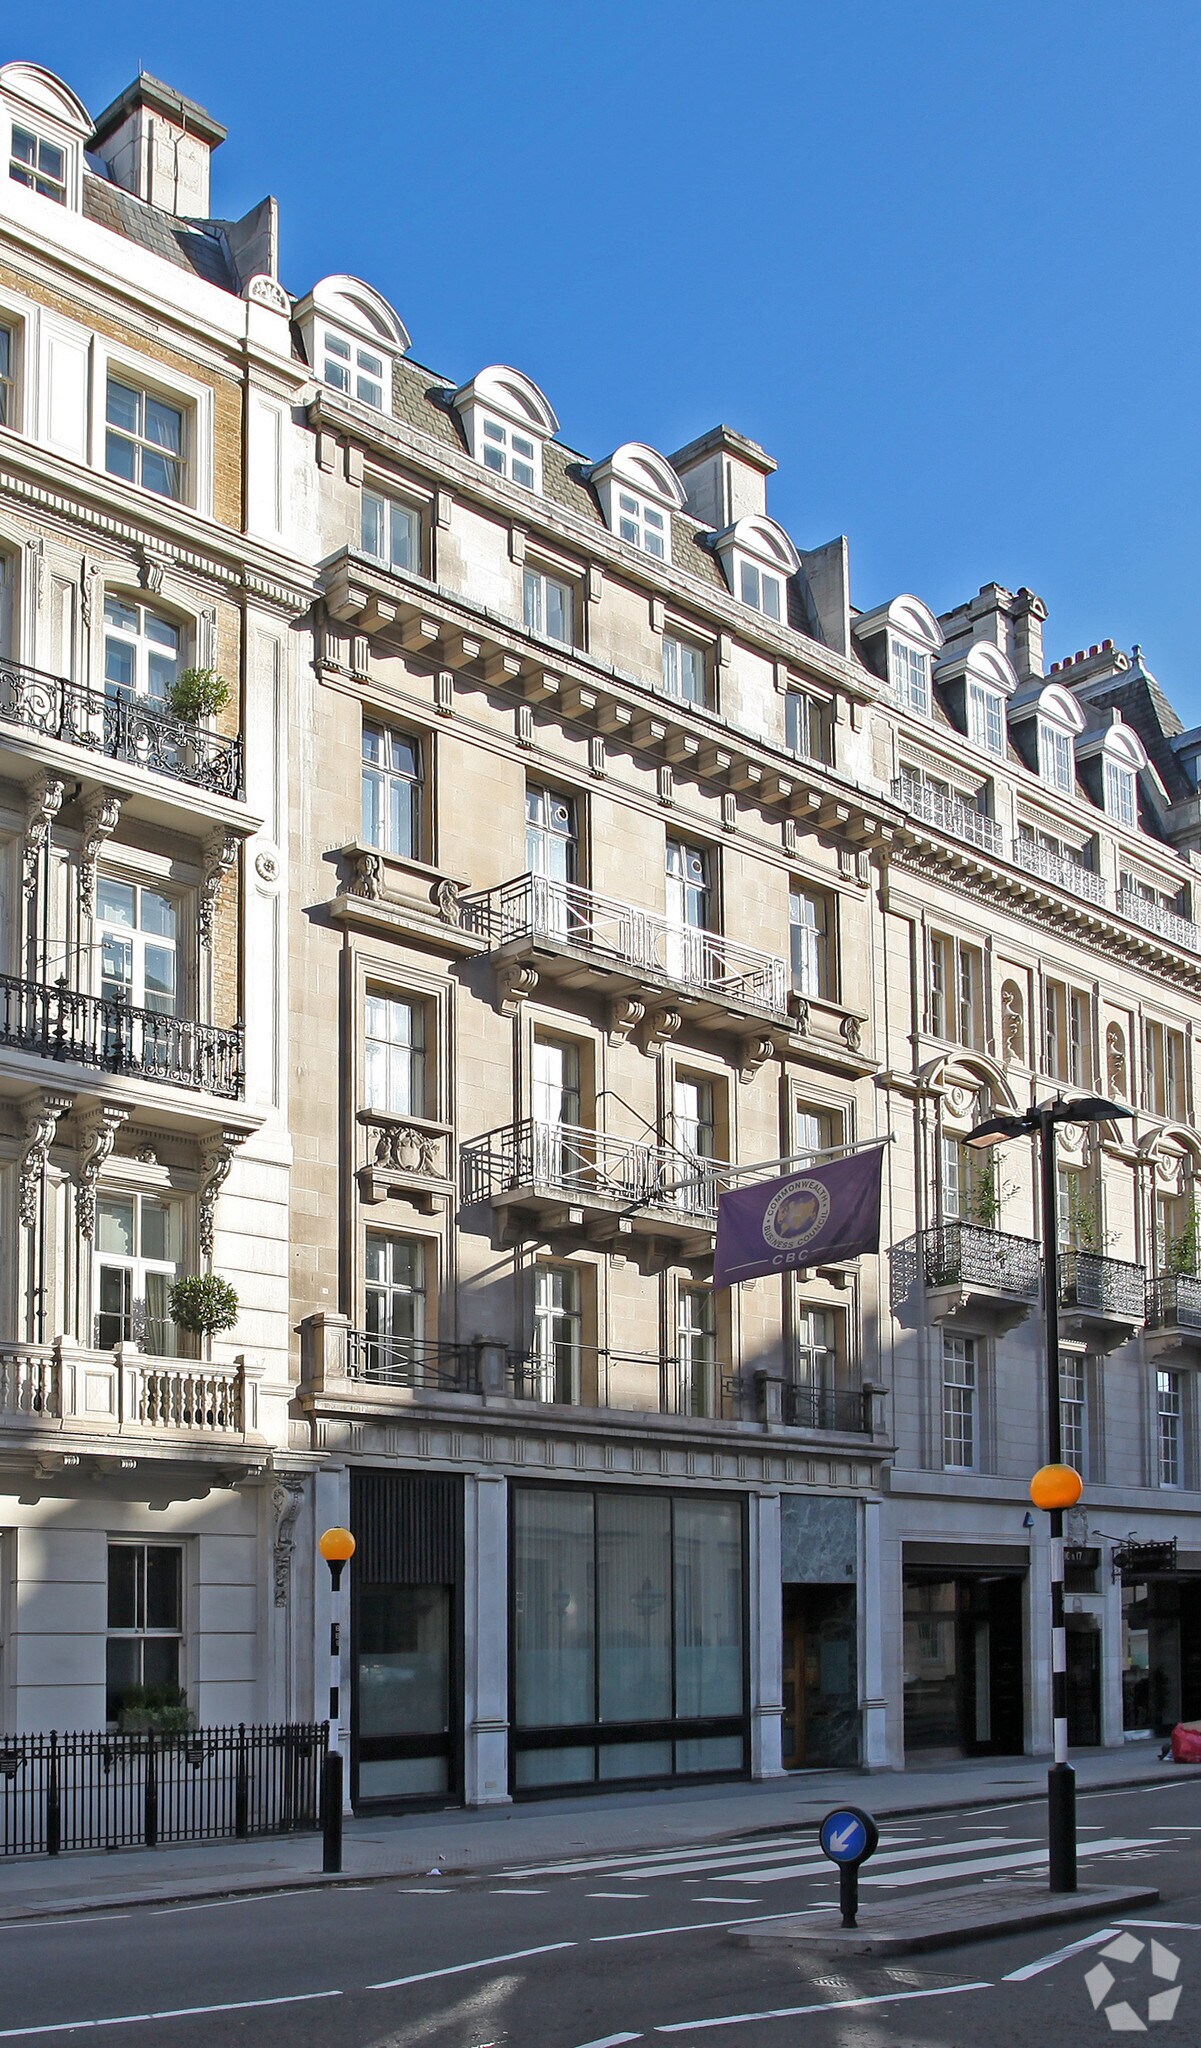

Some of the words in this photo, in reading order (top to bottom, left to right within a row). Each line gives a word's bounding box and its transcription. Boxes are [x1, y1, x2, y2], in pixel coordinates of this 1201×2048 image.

[768, 1181, 828, 1216] COMMONWEALTH
[764, 1225, 794, 1249] BUSINESS
[797, 1210, 828, 1246] COUNCIL
[772, 1249, 809, 1265] CBC
